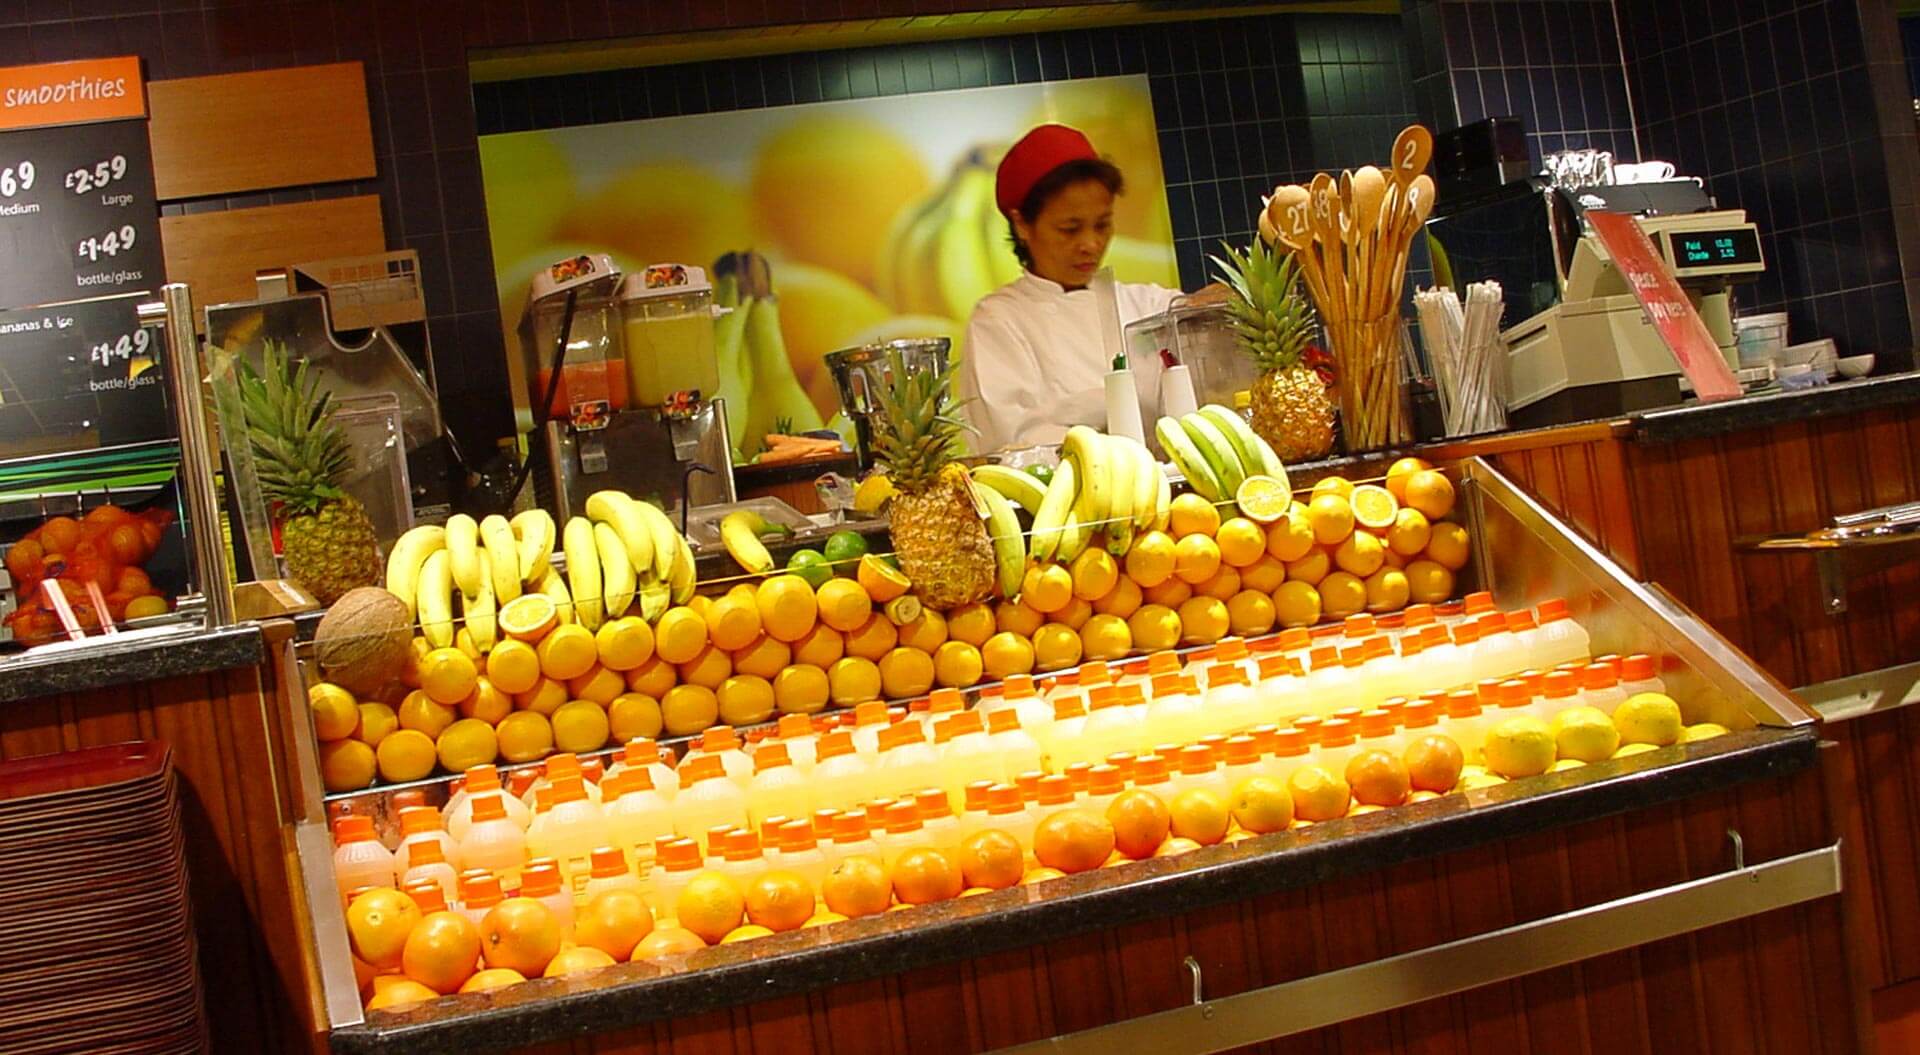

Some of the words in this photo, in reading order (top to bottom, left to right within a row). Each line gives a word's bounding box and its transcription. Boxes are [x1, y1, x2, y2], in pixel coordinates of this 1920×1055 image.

[4, 76, 126, 108] smoothies
[1402, 139, 1417, 169] 2
[64, 155, 127, 195] £2.59
[102, 194, 134, 206] Large
[1287, 201, 1310, 235] 27
[78, 225, 136, 262] £1.49
[77, 271, 143, 287] bottle/glass
[43, 317, 53, 329] &
[91, 329, 149, 367] £1.49
[90, 374, 156, 392] bottle/glass
